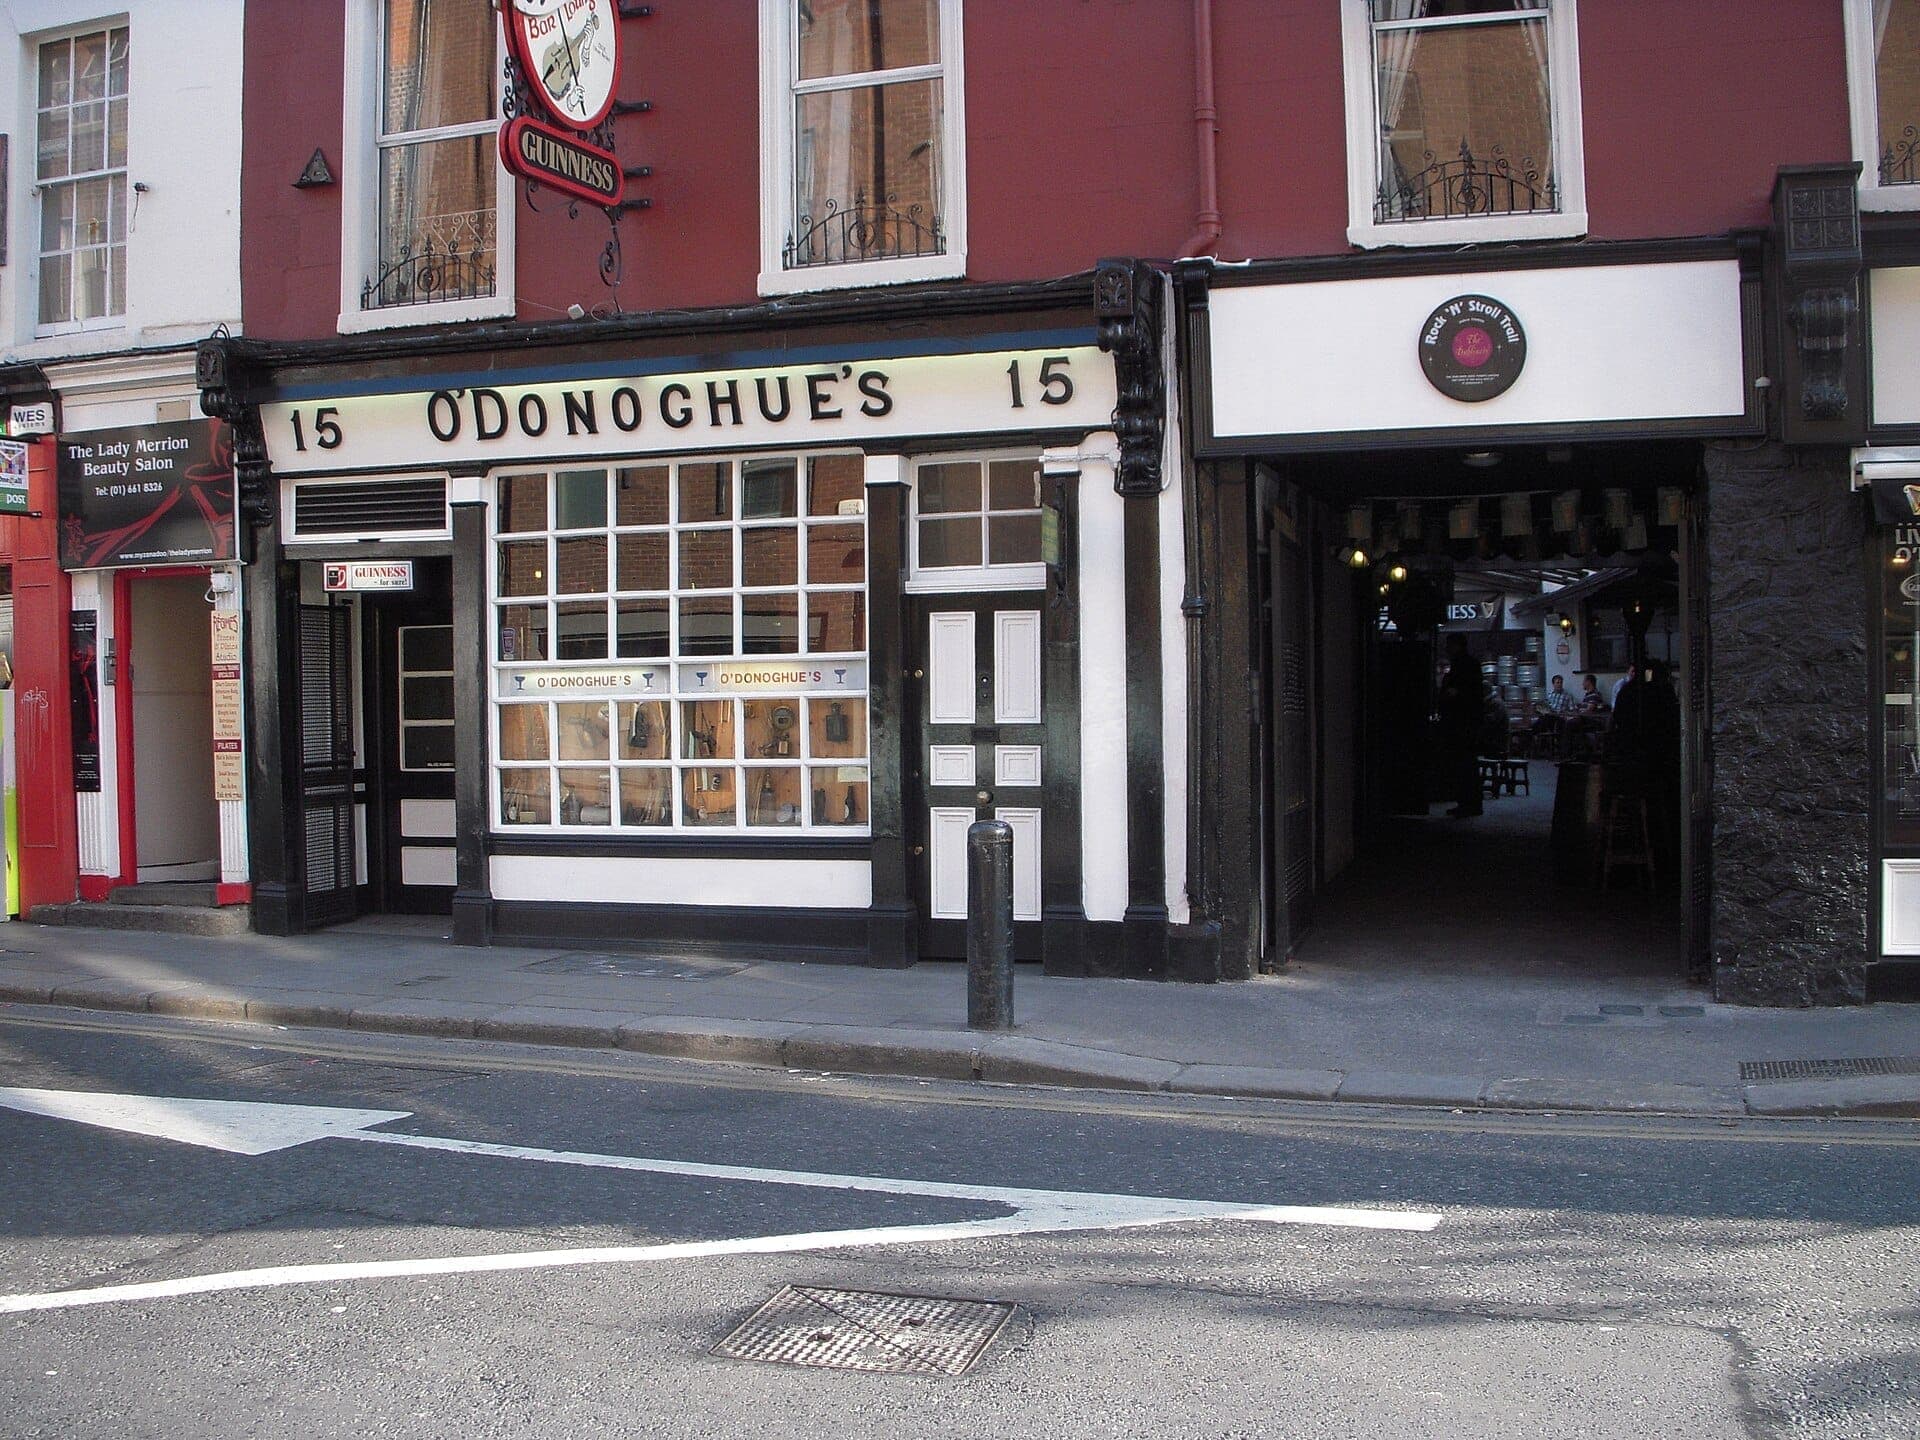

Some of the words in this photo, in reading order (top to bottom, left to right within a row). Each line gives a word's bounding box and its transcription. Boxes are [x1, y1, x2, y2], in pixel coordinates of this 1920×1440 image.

[522, 131, 614, 192] GUINNESS
[1425, 316, 1447, 345] Rock
[1469, 300, 1501, 319] Stroll
[1499, 315, 1520, 343] Trail
[290, 407, 343, 451] 15
[427, 364, 894, 441] O'DONOGHUE'S
[1006, 356, 1074, 408] 15
[14, 409, 45, 422] WES
[69, 446, 93, 459] The
[98, 442, 130, 457] Lady
[135, 437, 189, 453] Merrion
[84, 461, 130, 476] Beauty
[135, 457, 173, 472] Salon
[110, 484, 126, 497] (01)
[127, 484, 141, 494] 661
[355, 567, 407, 578] GUINNESS
[537, 675, 632, 688] O'DONOGHUE'S
[720, 671, 822, 684] O'DONOGHUE'S
